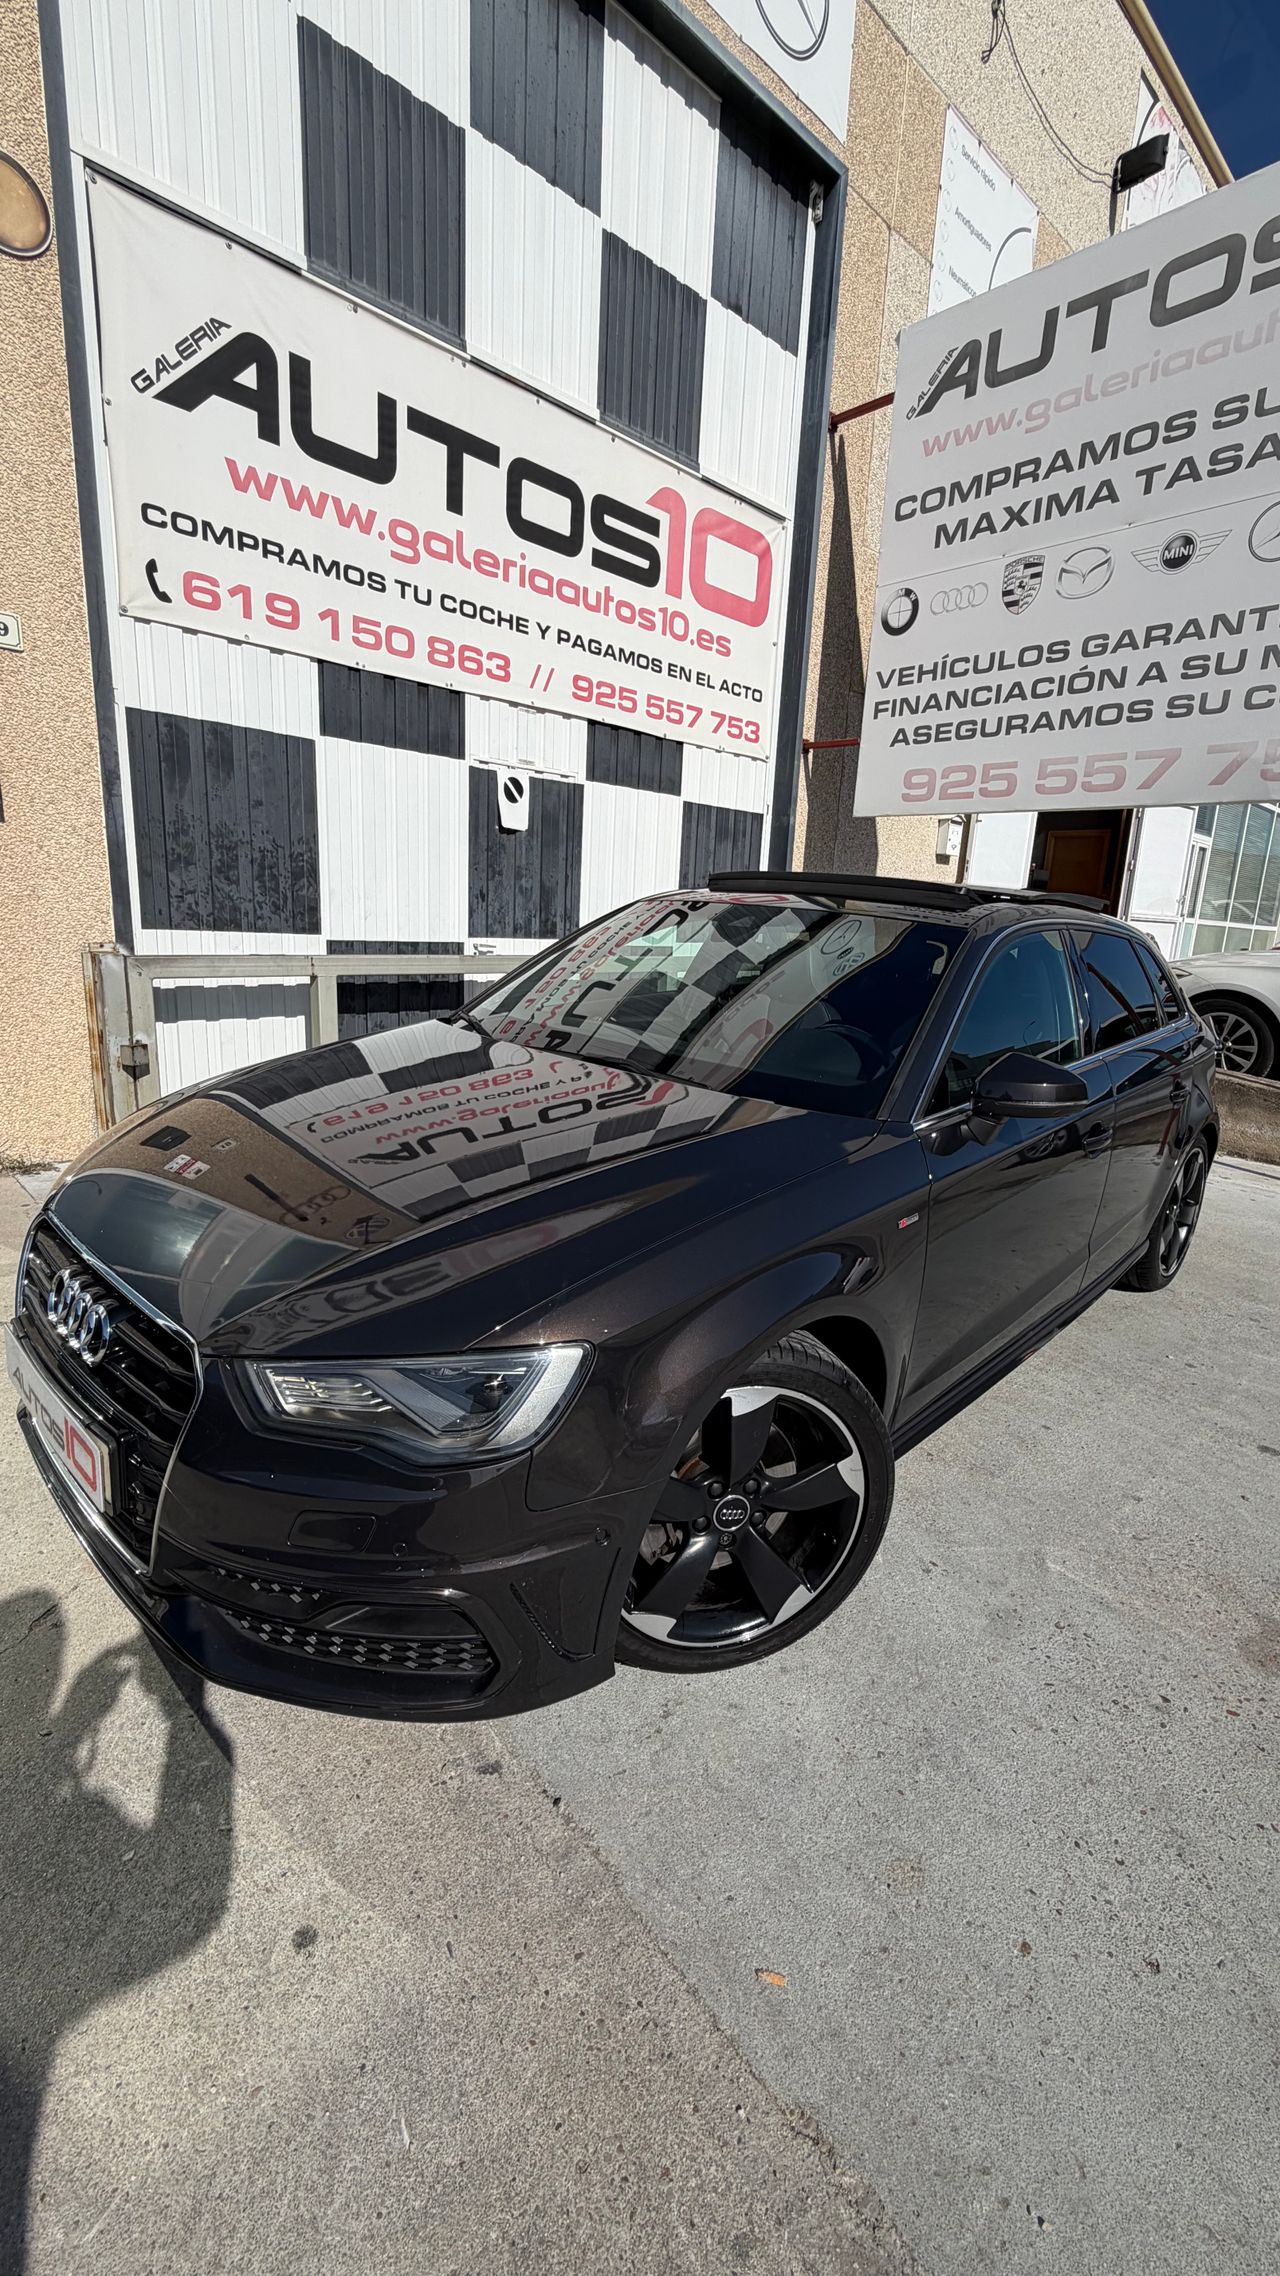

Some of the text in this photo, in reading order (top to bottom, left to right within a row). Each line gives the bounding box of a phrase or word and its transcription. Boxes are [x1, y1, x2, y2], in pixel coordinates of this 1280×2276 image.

[130, 317, 232, 394] GALERIA
[906, 346, 959, 420] GALERIA
[922, 307, 1280, 458] www.galeriaaut
[152, 331, 773, 627] AUTOS10
[895, 409, 1198, 522] COMPRAMOS
[933, 432, 1280, 549] MAXIMA TASA
[224, 456, 732, 659] www.galeriaautos10.es
[1163, 544, 1194, 561] MINI
[141, 502, 763, 703] COMPRAMOS TU COCHE Y PAGAMOS EN EL ACTO
[875, 604, 1280, 689] VEHÍCULOS GARANT
[182, 570, 301, 630] 619
[318, 607, 415, 659] 150
[427, 635, 511, 683] 863
[572, 674, 638, 713] 925
[645, 693, 703, 728] 557
[710, 711, 760, 743] 753
[873, 665, 1127, 720] FINANCIACIÓN
[1136, 661, 1168, 687] A
[1180, 648, 1248, 680] SU
[889, 684, 1280, 747] ASEGURAMOS SU C
[901, 761, 1019, 803] 925
[1034, 747, 1182, 796] 557
